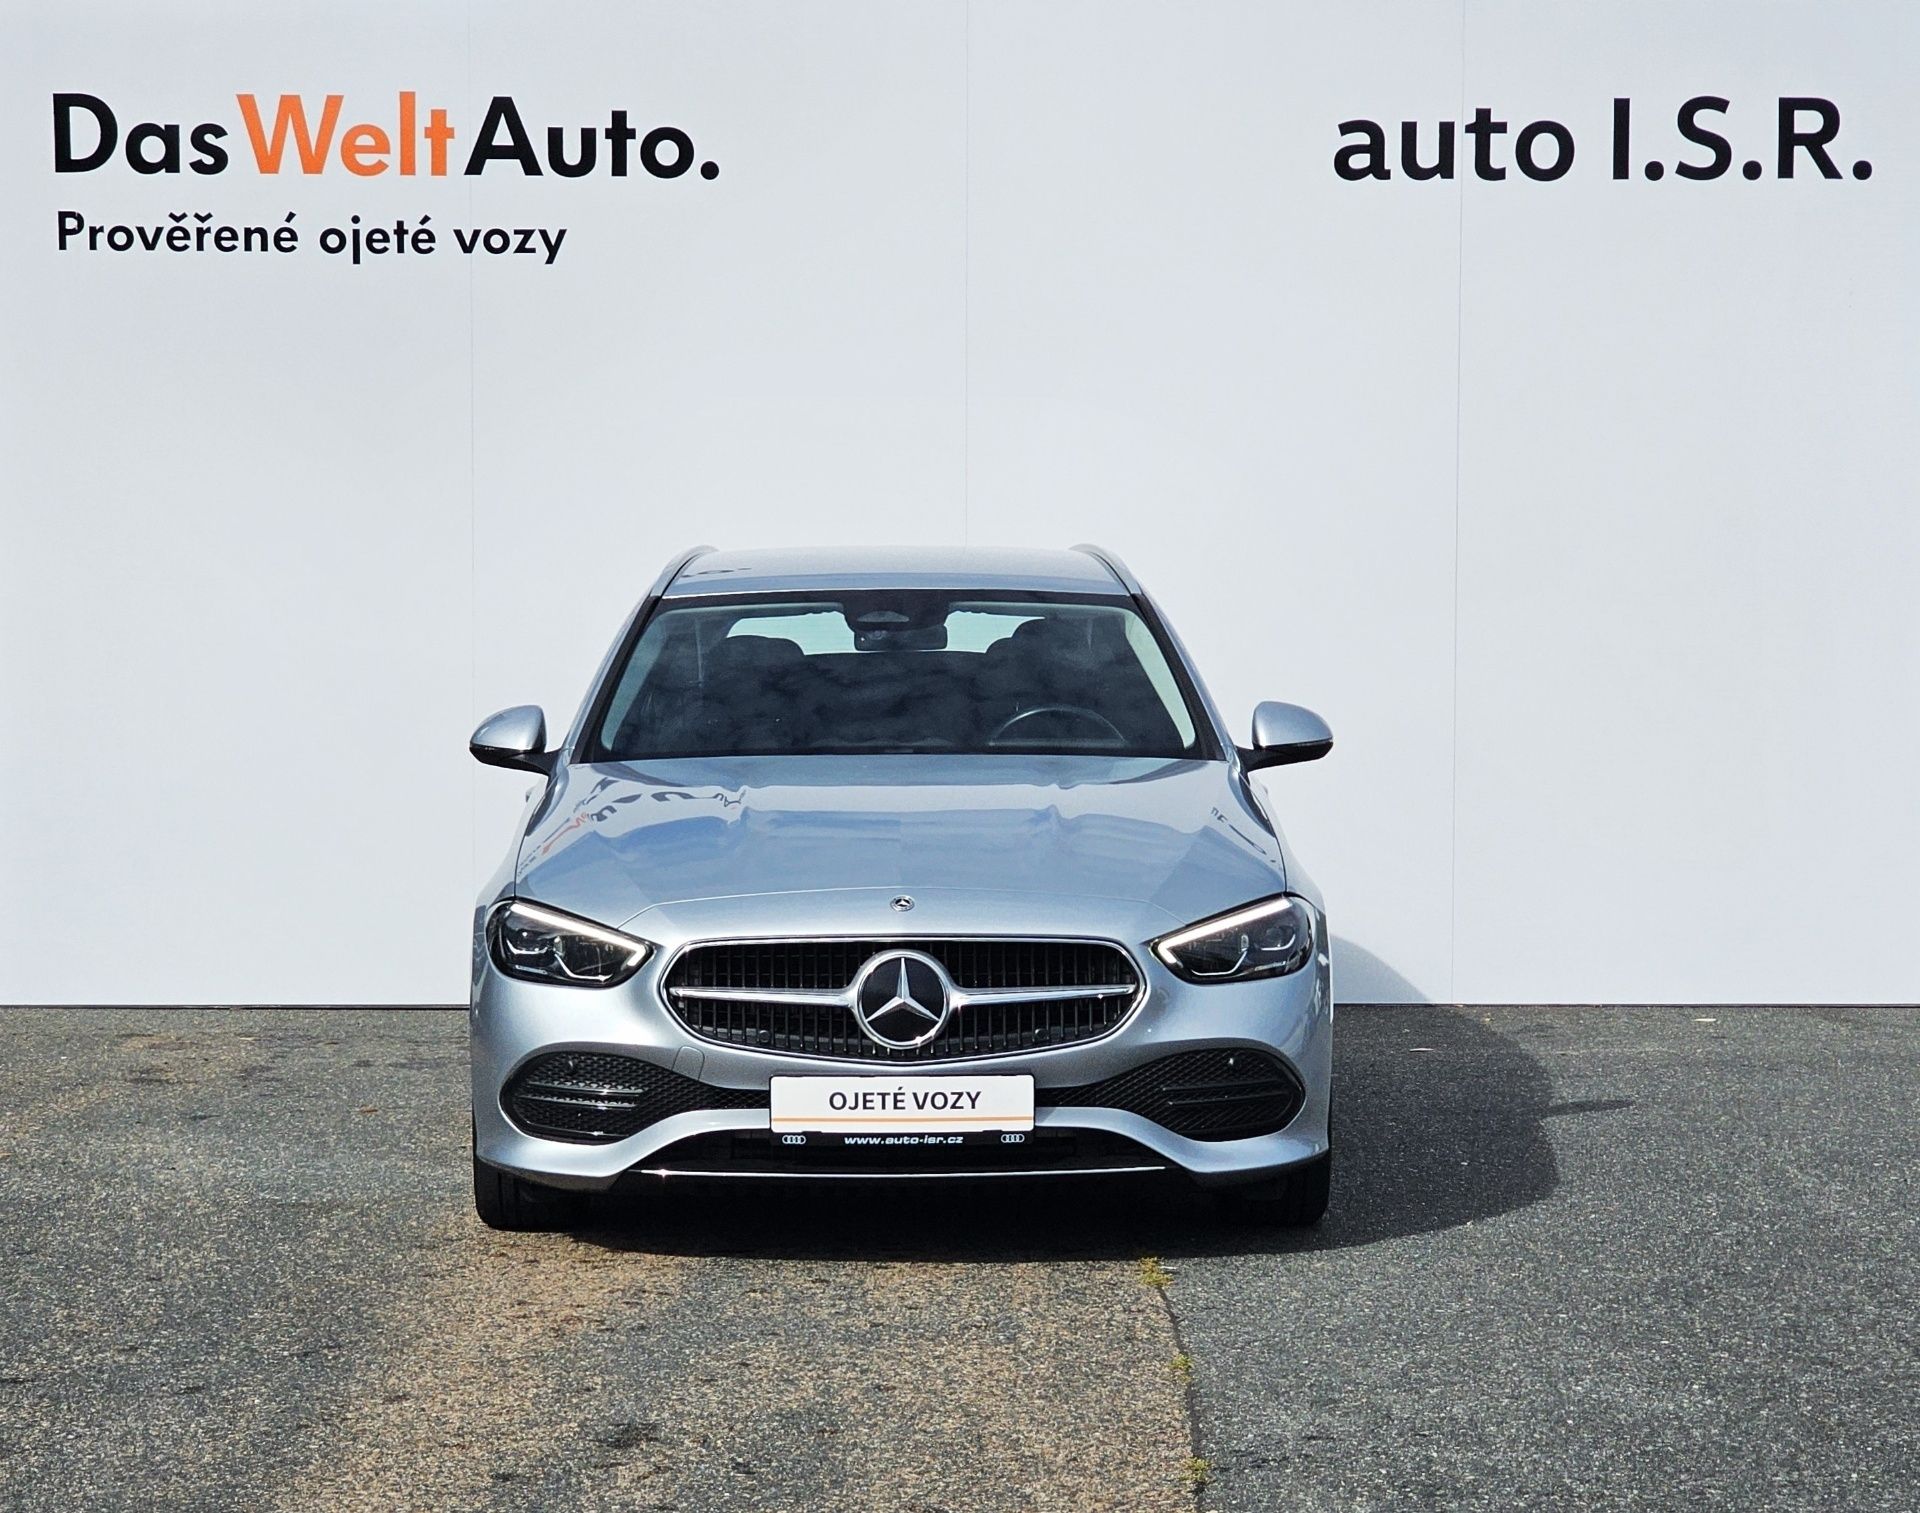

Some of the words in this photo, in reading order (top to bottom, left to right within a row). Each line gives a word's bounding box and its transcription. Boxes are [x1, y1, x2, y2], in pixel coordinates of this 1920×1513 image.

[1333, 107, 1575, 182] auto
[1612, 95, 1873, 182] I.S.R.
[57, 210, 299, 254] Prověřené
[319, 213, 437, 265] ojeté
[452, 227, 568, 265] vozy
[829, 1086, 906, 1111] OJETÉ
[912, 1091, 982, 1110] VOZY
[844, 1134, 964, 1145] www.auto-isr.cz
